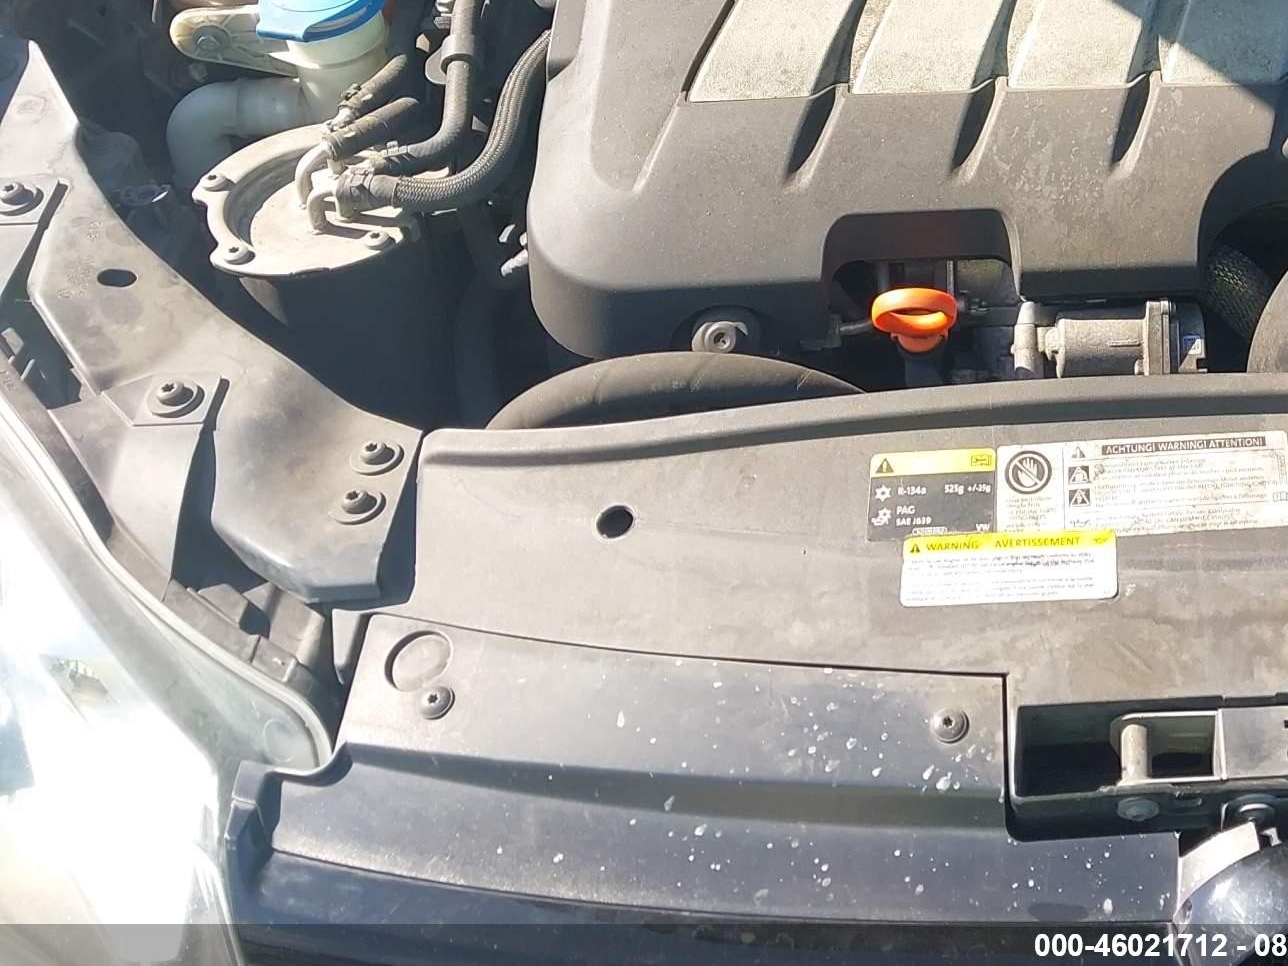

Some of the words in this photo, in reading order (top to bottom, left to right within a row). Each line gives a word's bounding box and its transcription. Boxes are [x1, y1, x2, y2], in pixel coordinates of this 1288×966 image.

[1105, 442, 1156, 454] ACHTUNG!
[1158, 440, 1207, 452] WARNING!
[1208, 436, 1263, 449] ATTENTION!
[897, 485, 927, 496] R-134a
[944, 483, 965, 496] 525g
[967, 483, 992, 494] +/-25g
[896, 505, 916, 515] PAG
[896, 517, 911, 527] SAE
[975, 523, 991, 532] VW
[926, 538, 980, 551] WARNING
[994, 536, 1081, 549] AVERTISSEMENT
